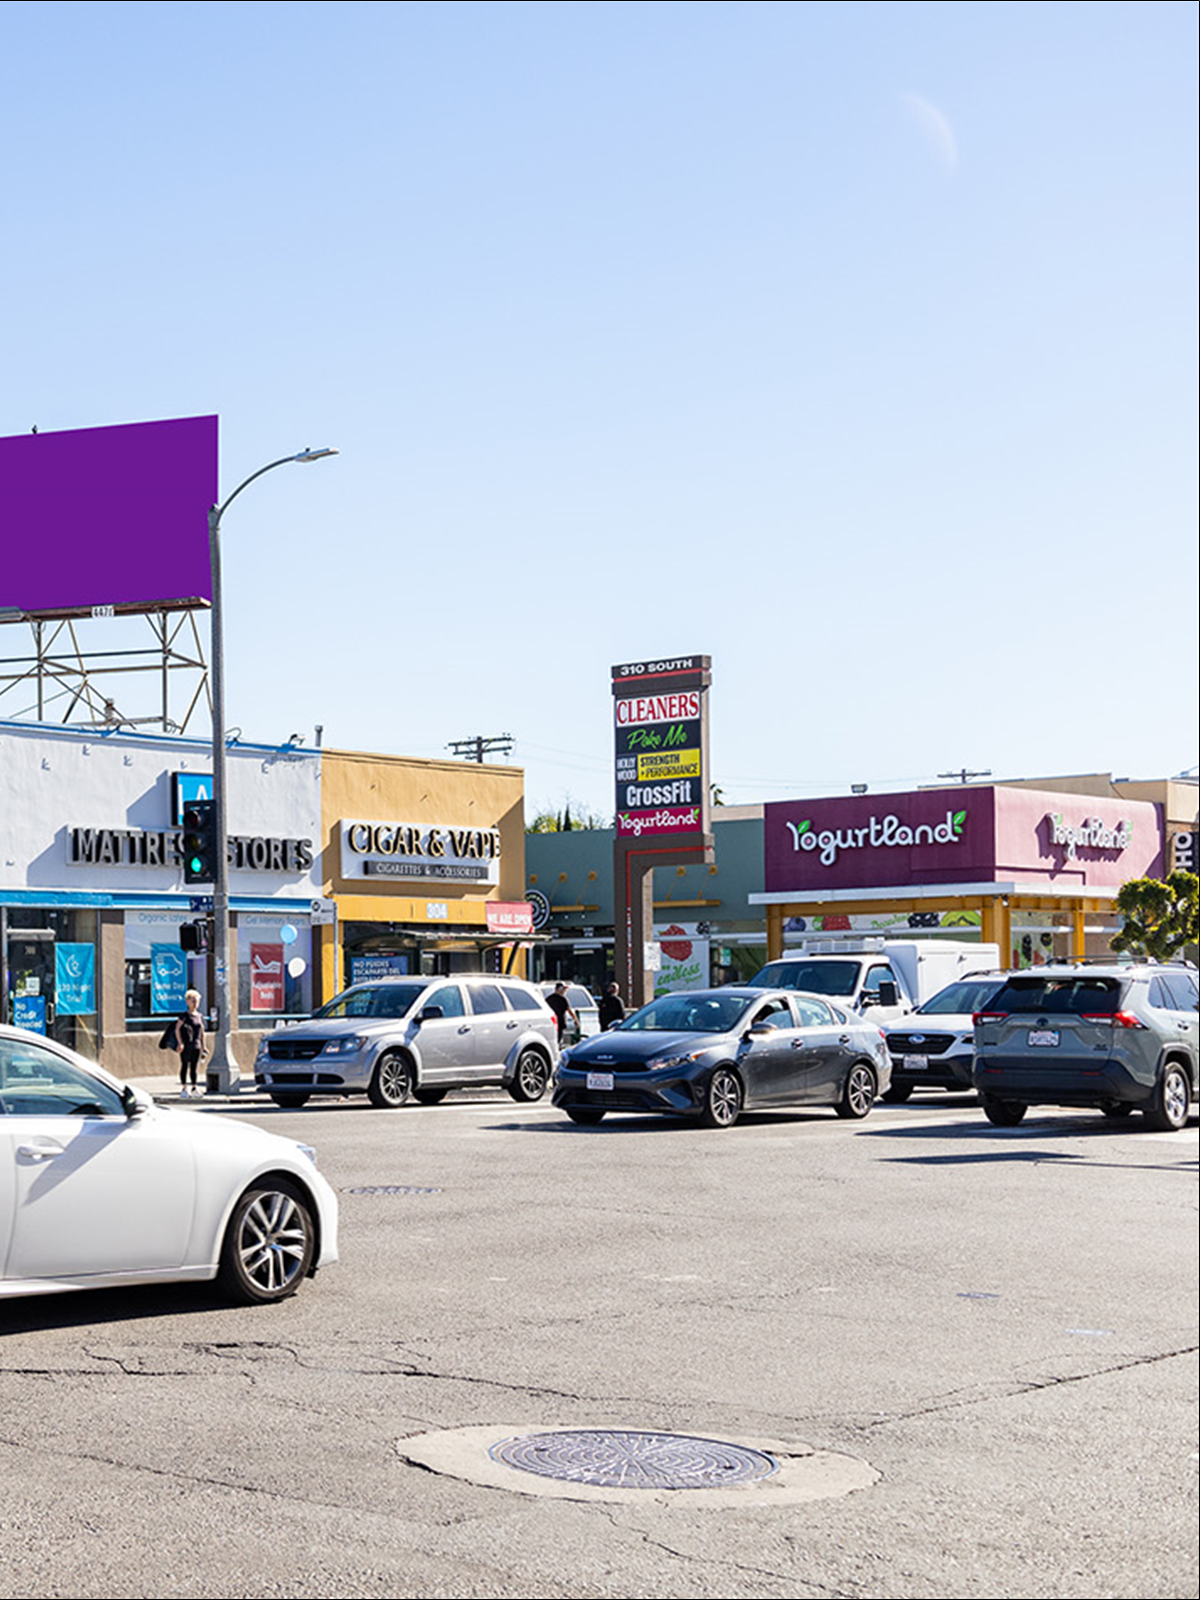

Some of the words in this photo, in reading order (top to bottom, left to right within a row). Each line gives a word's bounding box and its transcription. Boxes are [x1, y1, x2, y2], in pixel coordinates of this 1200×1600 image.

[620, 664, 645, 676] 310
[647, 659, 693, 672] SOUTH
[617, 692, 699, 724] CLEANERS
[640, 754, 680, 767] STRENGTH
[645, 762, 698, 778] PERFORMANCE
[626, 780, 691, 807] CrossFit
[618, 808, 698, 836] Yogurtland
[349, 823, 423, 856] CIGAR
[428, 829, 448, 858] &
[450, 829, 502, 859] VAPE
[786, 811, 960, 866] Yogurtland
[1050, 813, 1131, 861] Yogurtland
[72, 828, 184, 865] MATTRE
[376, 863, 422, 875] CIGARETTES
[425, 867, 431, 875] &
[434, 866, 482, 878] ACCESSORIES
[138, 912, 167, 923] Organic
[168, 913, 188, 923] Latex
[487, 914, 499, 924] WE
[500, 914, 512, 924] ARE
[15, 1001, 27, 1011] No
[15, 1010, 36, 1020] Credit
